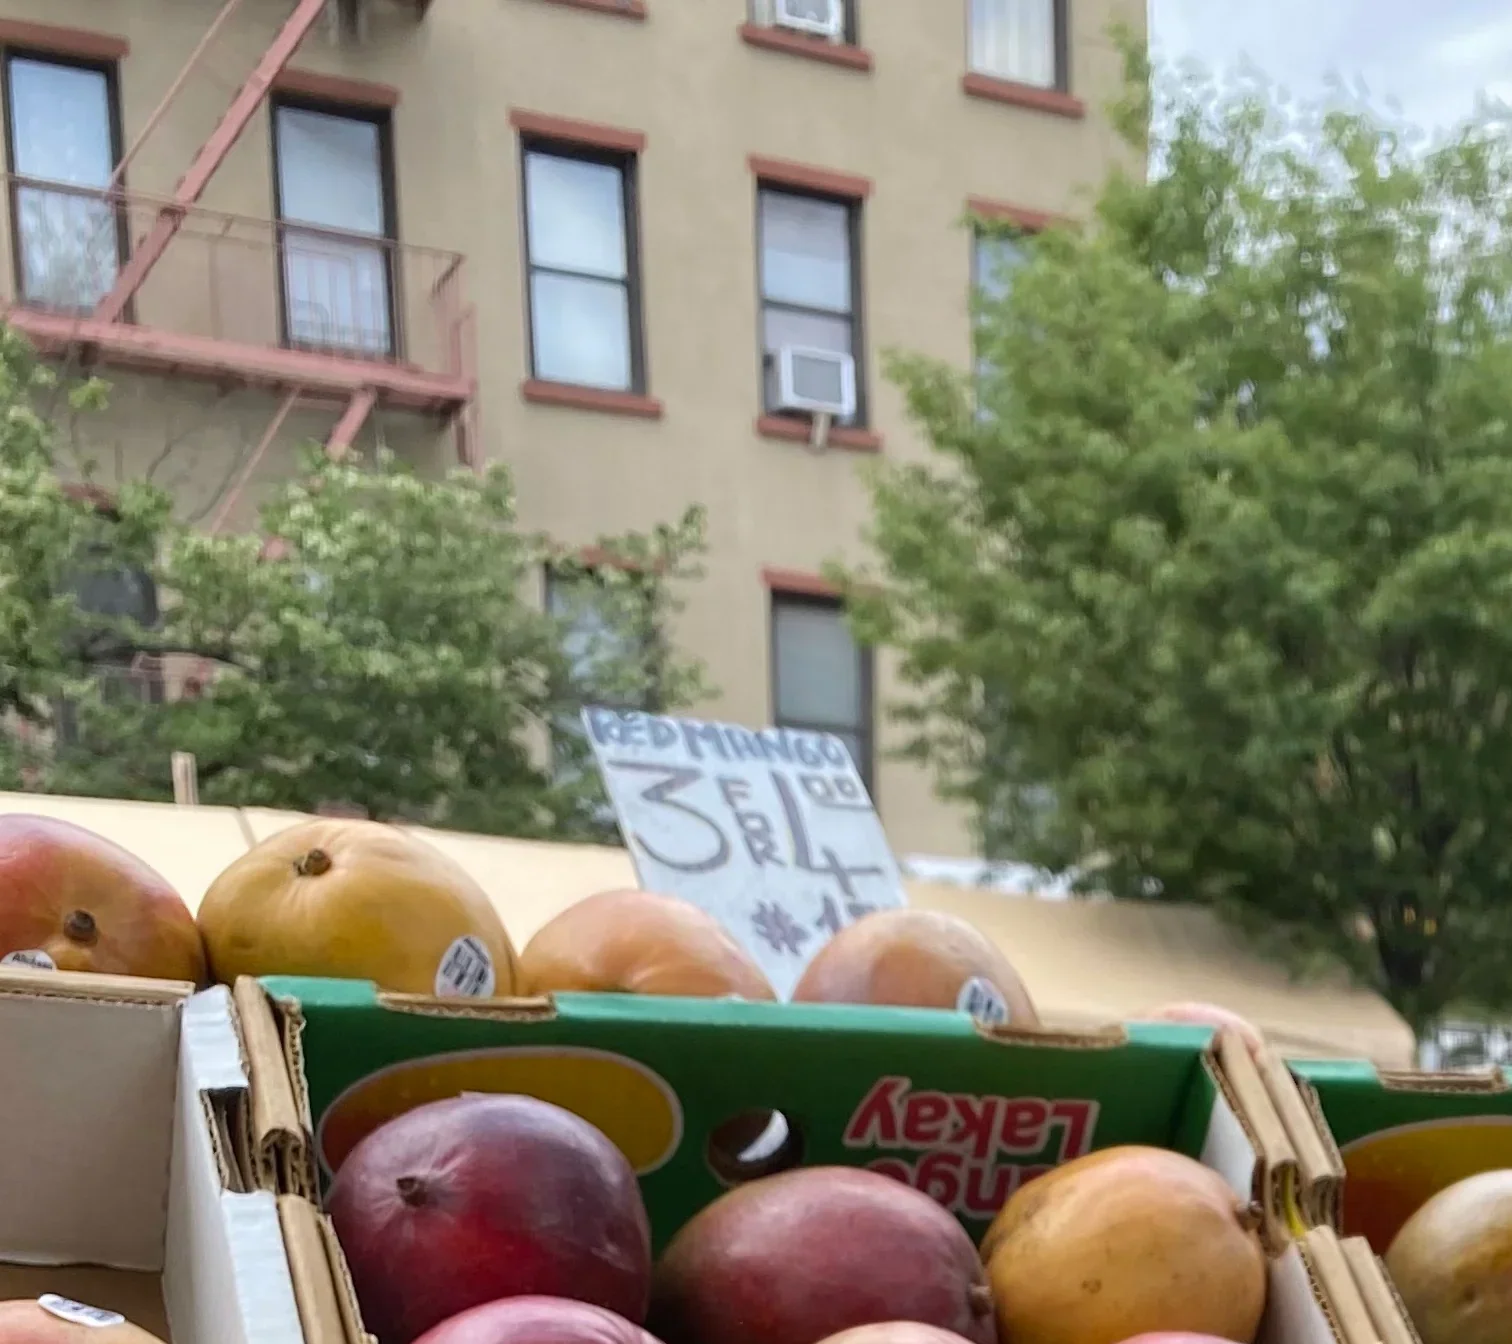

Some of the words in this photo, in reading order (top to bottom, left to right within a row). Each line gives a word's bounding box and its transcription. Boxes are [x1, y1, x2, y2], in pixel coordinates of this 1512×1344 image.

[677, 720, 848, 768] MANGO
[607, 759, 731, 871] 3
[843, 1075, 1100, 1162] Lakay
